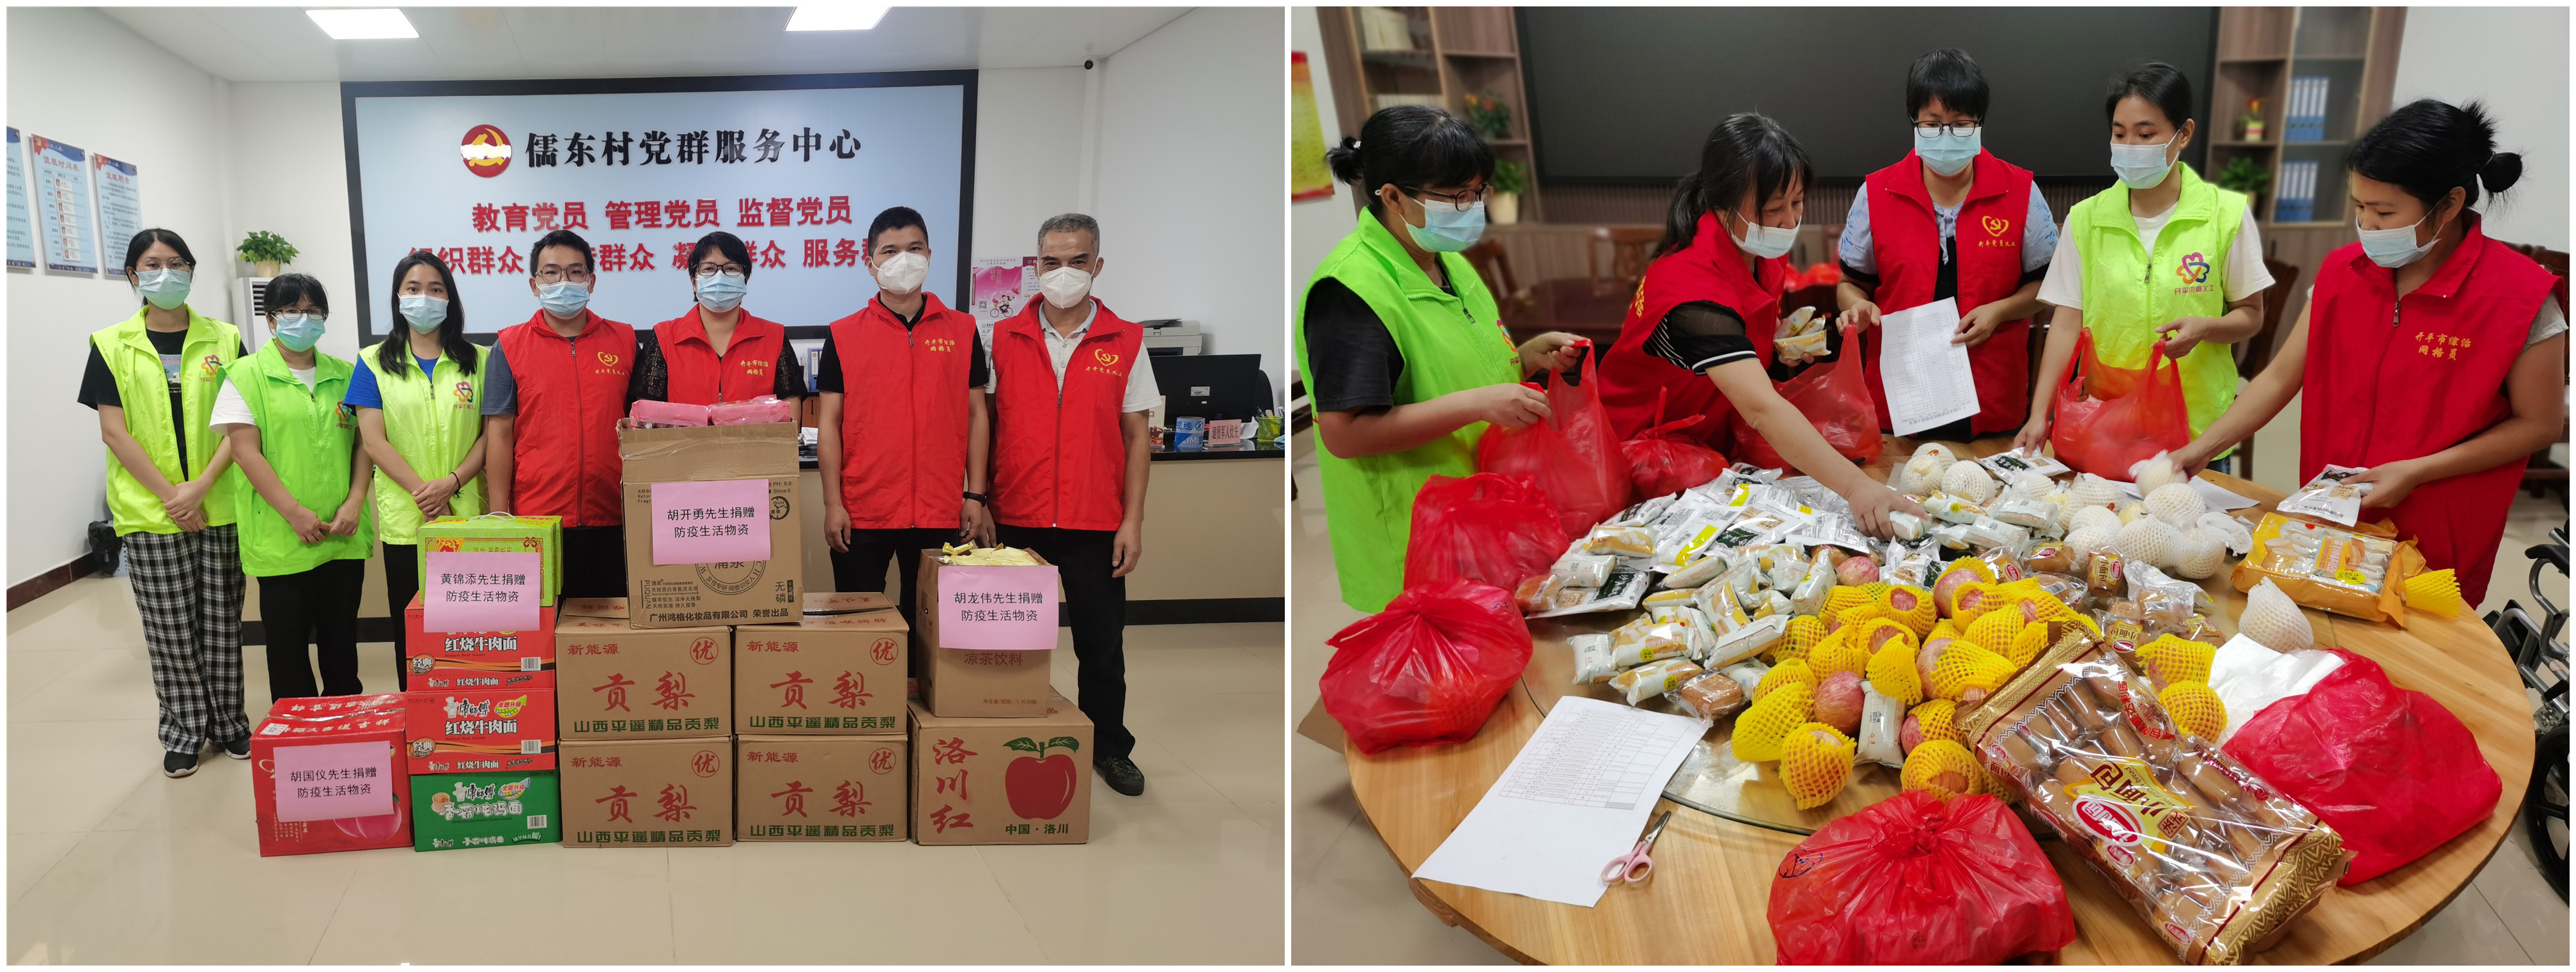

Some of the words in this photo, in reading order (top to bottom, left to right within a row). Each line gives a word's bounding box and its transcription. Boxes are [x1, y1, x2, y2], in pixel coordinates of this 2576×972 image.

[525, 127, 862, 169] 儒东村党群服务中心
[472, 201, 589, 232] 教育党员
[605, 198, 720, 230] 管理党员
[737, 195, 852, 228] 监督党员
[2415, 331, 2472, 348] 开平市综治
[2418, 345, 2458, 361] 网格员
[1211, 425, 1239, 439] 退役军人优先
[667, 506, 755, 521] 胡开勇先生捐赠
[674, 524, 749, 538] 防疫生活物资
[2099, 560, 2109, 582] 小面包
[440, 573, 525, 586] 黄锦添先生捐赠
[446, 591, 519, 602] 防疫生活物资
[954, 592, 1043, 604] 胡龙伟先生捐赠
[649, 610, 748, 622] 广州鸿格化妆品有限公司
[752, 608, 788, 618] 荣誉出品
[961, 609, 1037, 622] 防疫生活物资
[2110, 627, 2137, 640] 小面包
[444, 636, 518, 652] 红烧牛肉面
[568, 643, 620, 657] 新能源
[692, 639, 715, 663] 优
[746, 640, 799, 653] 新能源
[873, 640, 896, 663] 优
[412, 657, 433, 668] 经典
[964, 651, 1023, 666] 凉茶饮料
[456, 677, 499, 686] 红烧牛肉面
[593, 670, 696, 712] 贡梨
[770, 670, 874, 712] 贡梨
[445, 719, 518, 736] 红烧牛肉面
[573, 717, 720, 733] 山西平遥精品贡梨
[749, 715, 896, 730] 山西平遥精品贡梨
[413, 741, 433, 752] 经典
[457, 760, 499, 769] 红烧牛肉面
[570, 756, 623, 768] 新能源
[694, 752, 717, 776] 优
[746, 751, 799, 764] 新能源
[871, 749, 894, 772] 优
[290, 766, 377, 782] 胡国仪先生捐赠
[2125, 767, 2141, 783] bread
[297, 783, 371, 799] 防疫生活物资
[929, 736, 979, 834] 洛川红
[2089, 761, 2169, 818] 小面包
[595, 783, 697, 823] 贡梨
[770, 780, 873, 821] 贡梨
[439, 801, 523, 821] 香菇炖鸡面
[1005, 823, 1069, 835] 中国·洛川
[2162, 810, 2186, 835] 法式
[577, 828, 721, 844] 山西平遥精品贡梨
[749, 824, 895, 838] 山西平遥精品贡梨
[462, 836, 504, 845] 香菇炖鸡面
